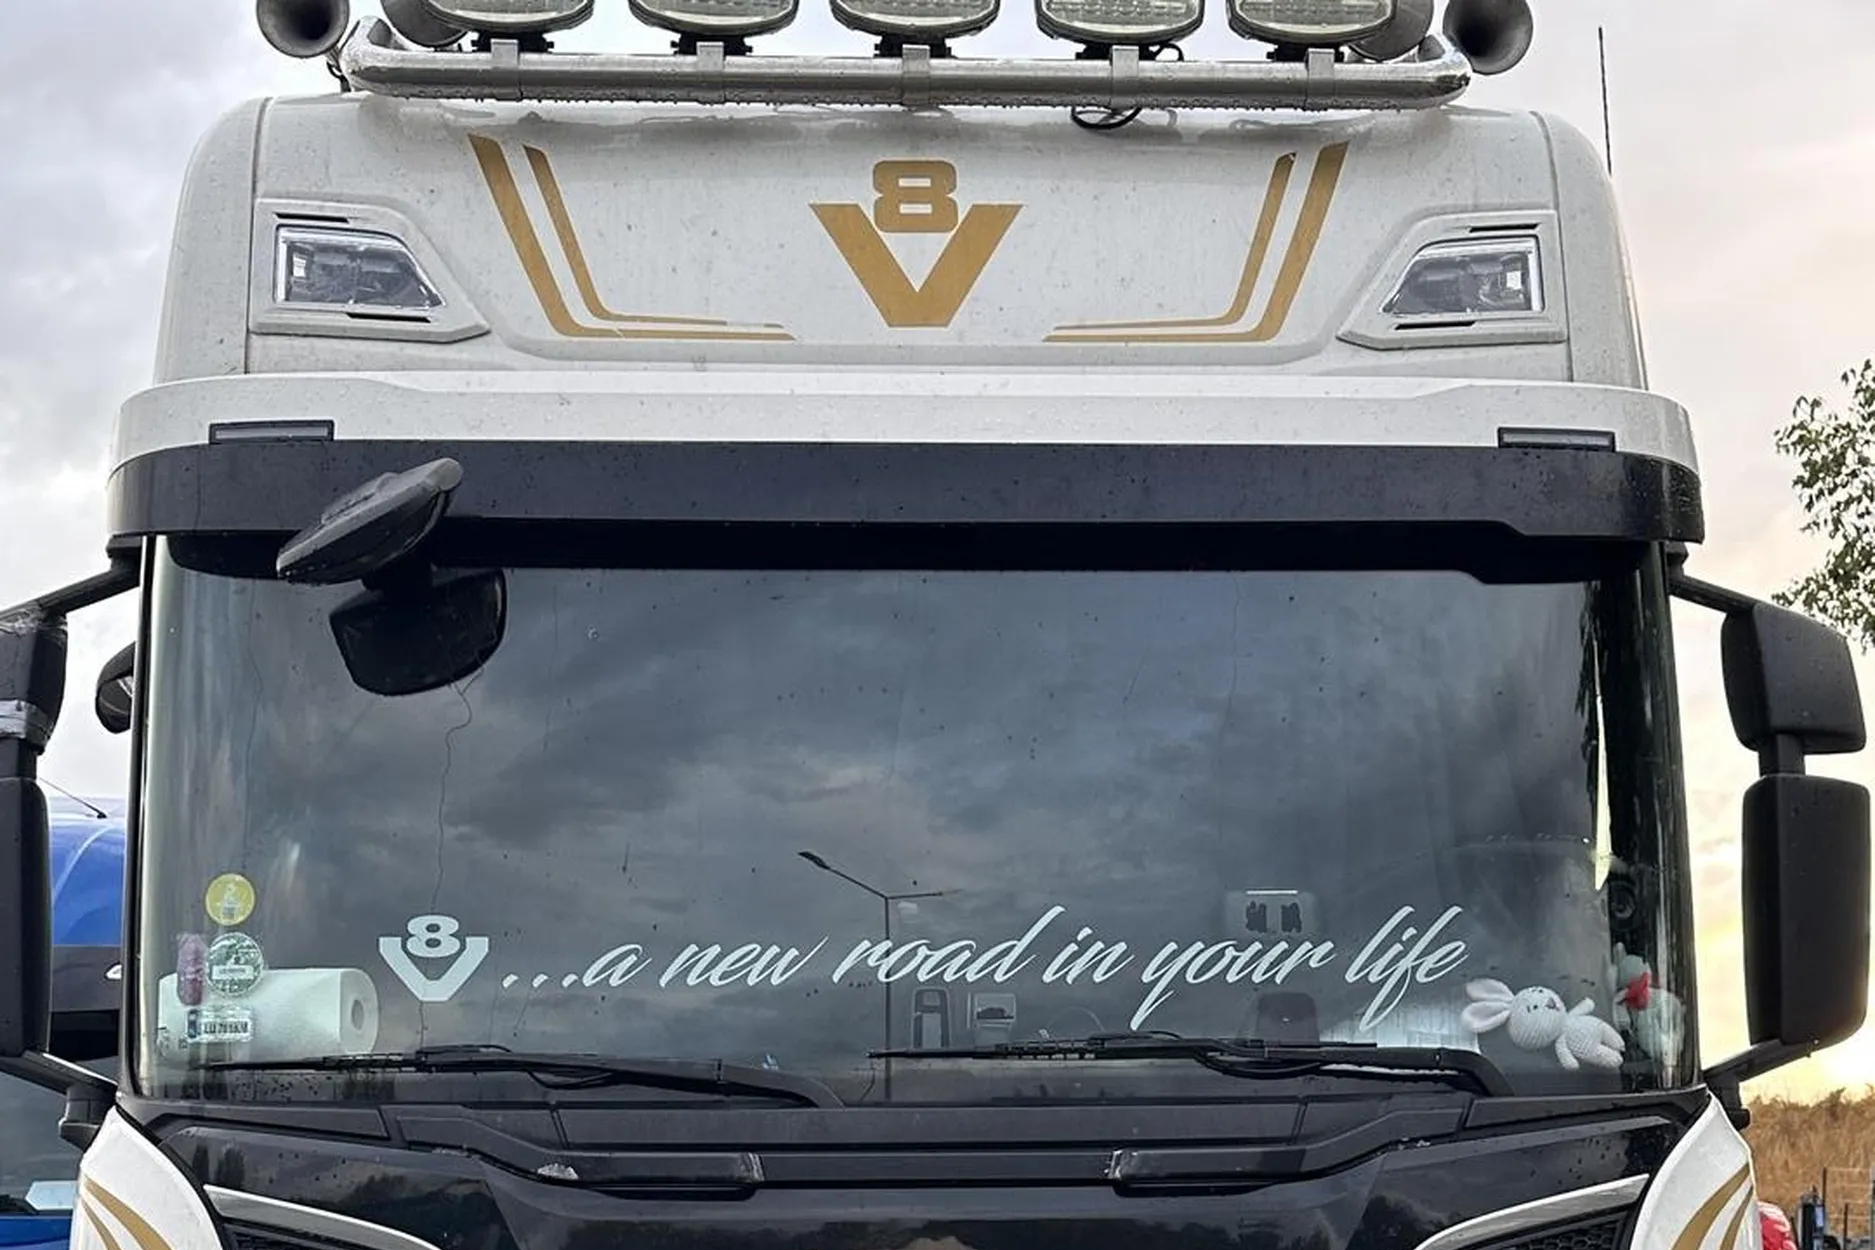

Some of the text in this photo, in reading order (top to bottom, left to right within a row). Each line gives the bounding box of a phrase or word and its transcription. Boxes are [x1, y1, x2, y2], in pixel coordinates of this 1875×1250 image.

[659, 935, 829, 988] new
[832, 904, 1066, 984] road
[1042, 926, 1134, 985] in
[1129, 938, 1337, 1031] your
[1344, 904, 1469, 1032] life
